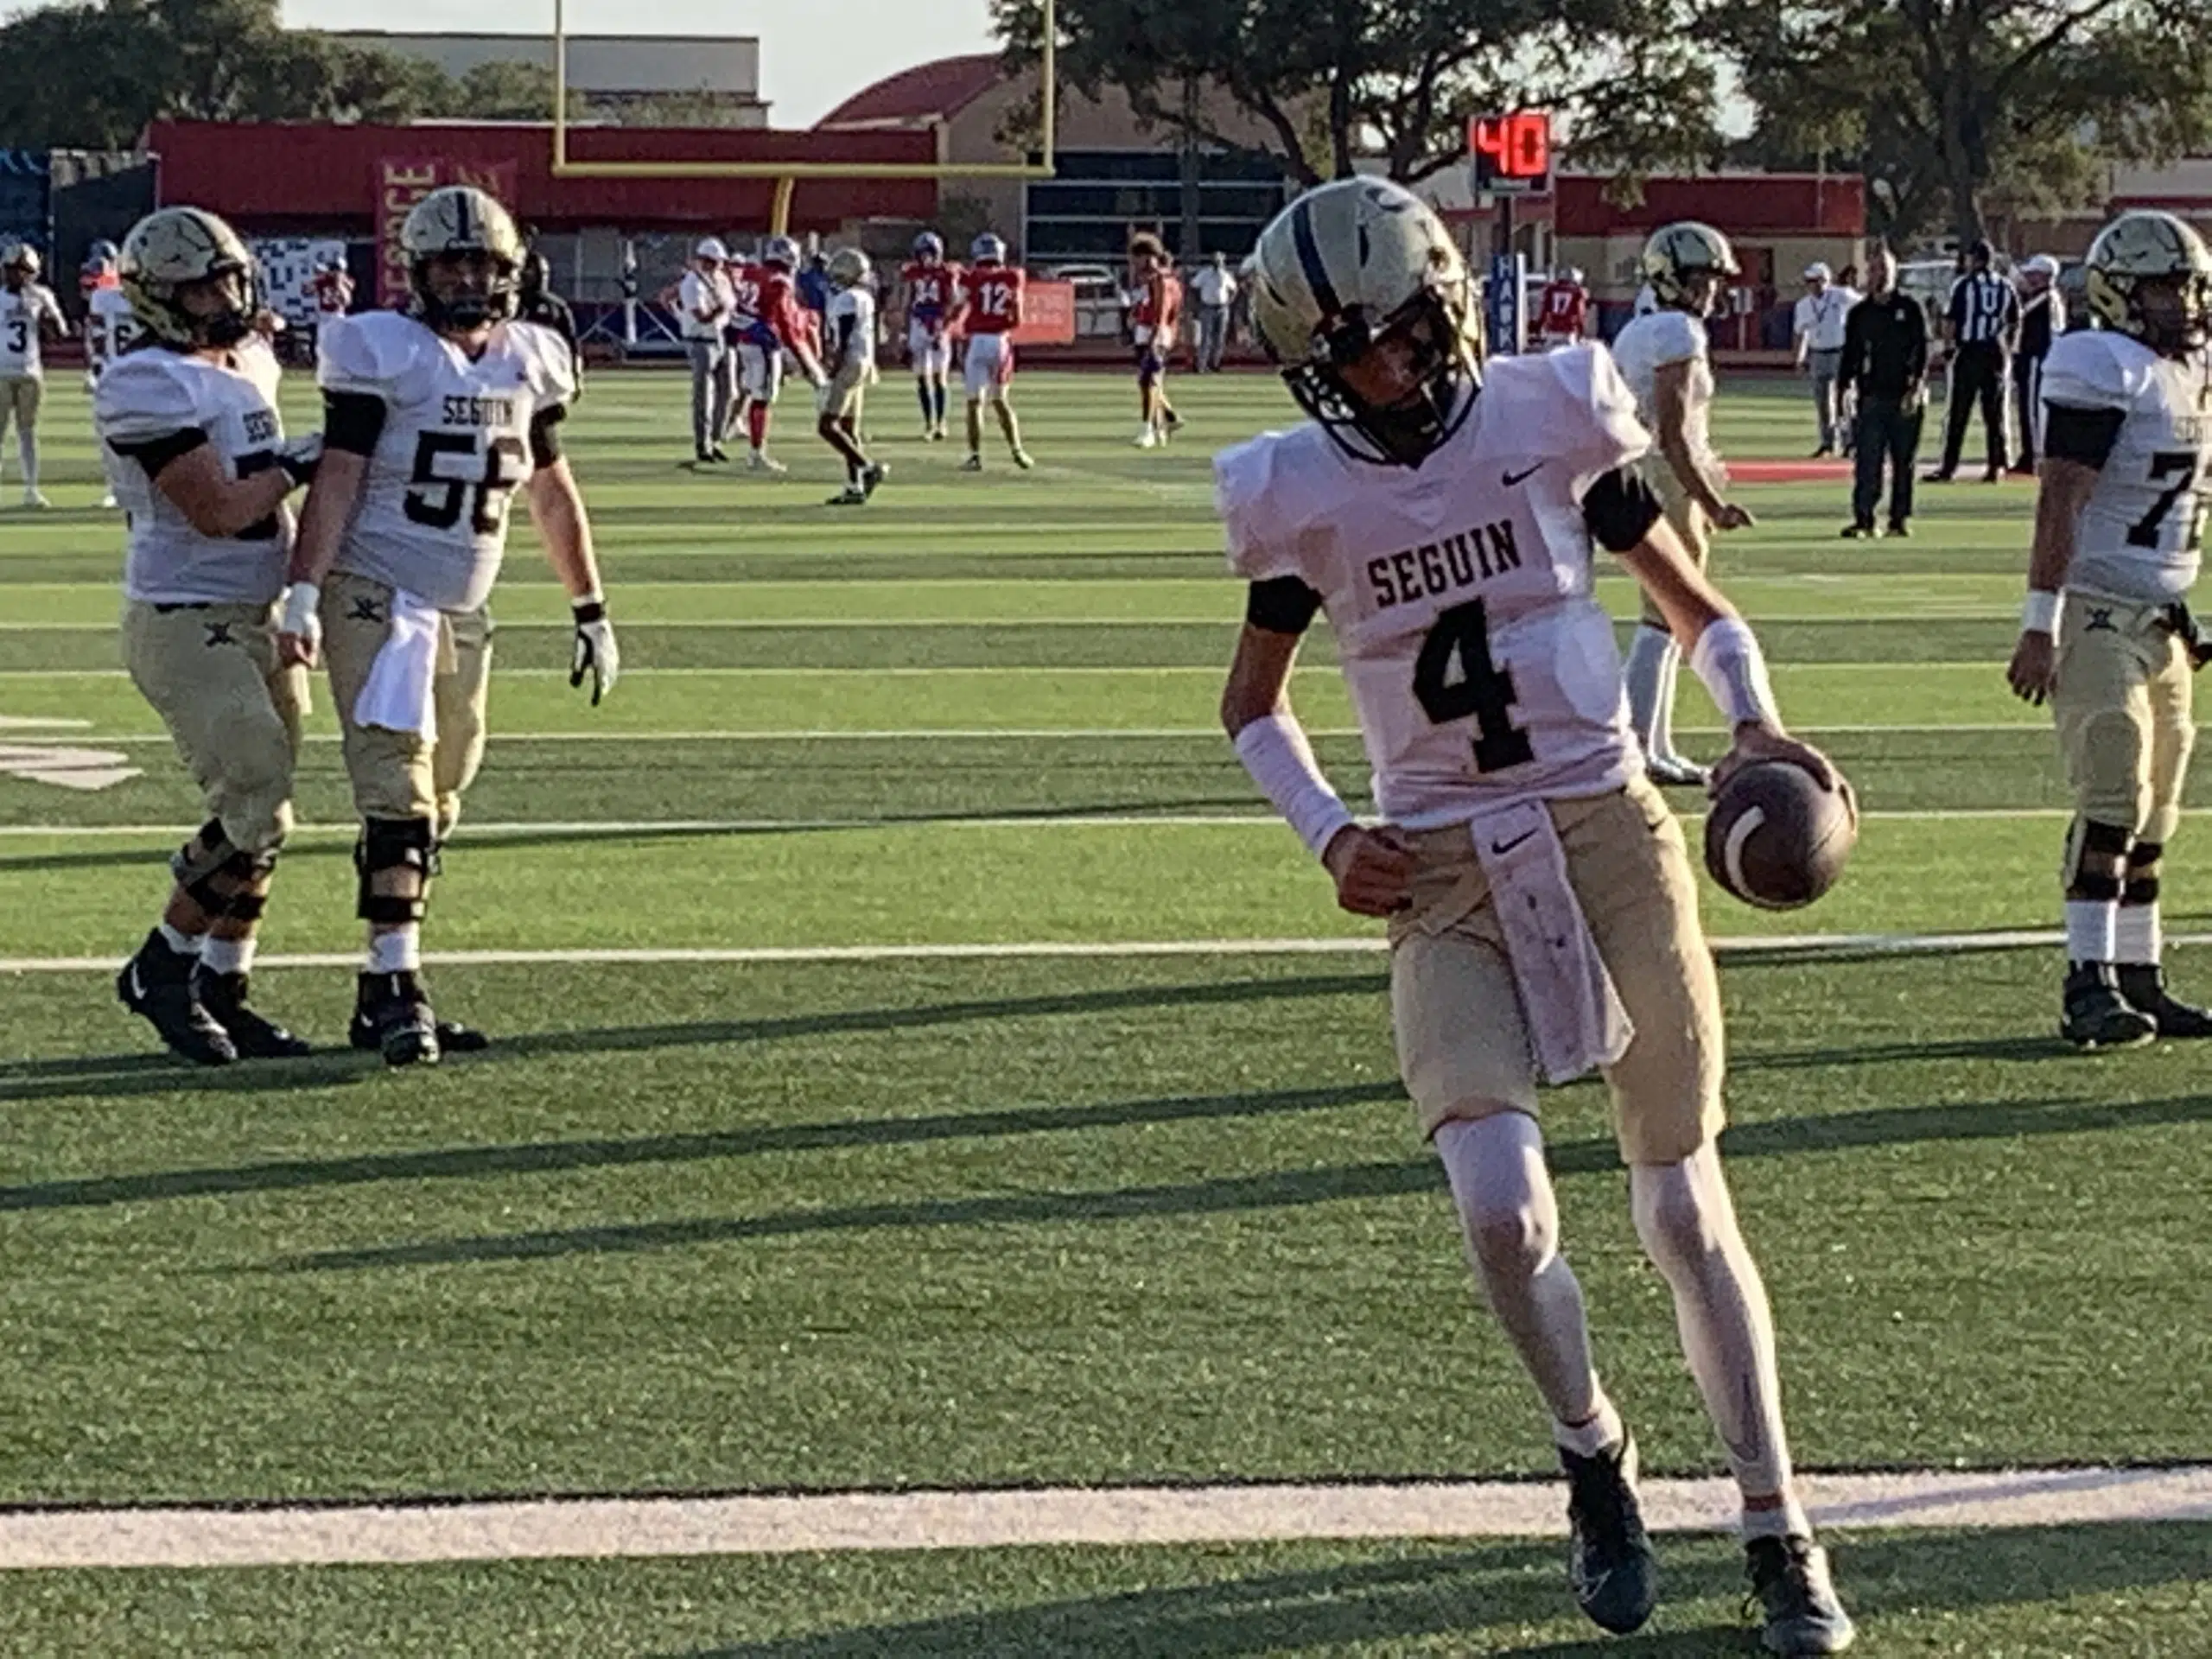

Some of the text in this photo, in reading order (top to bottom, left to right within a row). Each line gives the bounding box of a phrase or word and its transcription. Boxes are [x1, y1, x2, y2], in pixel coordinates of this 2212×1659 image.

[1478, 117, 1546, 175] 40
[980, 282, 1010, 315] 12
[1367, 518, 1523, 607] SEGUIN
[1412, 594, 1535, 774] 4
